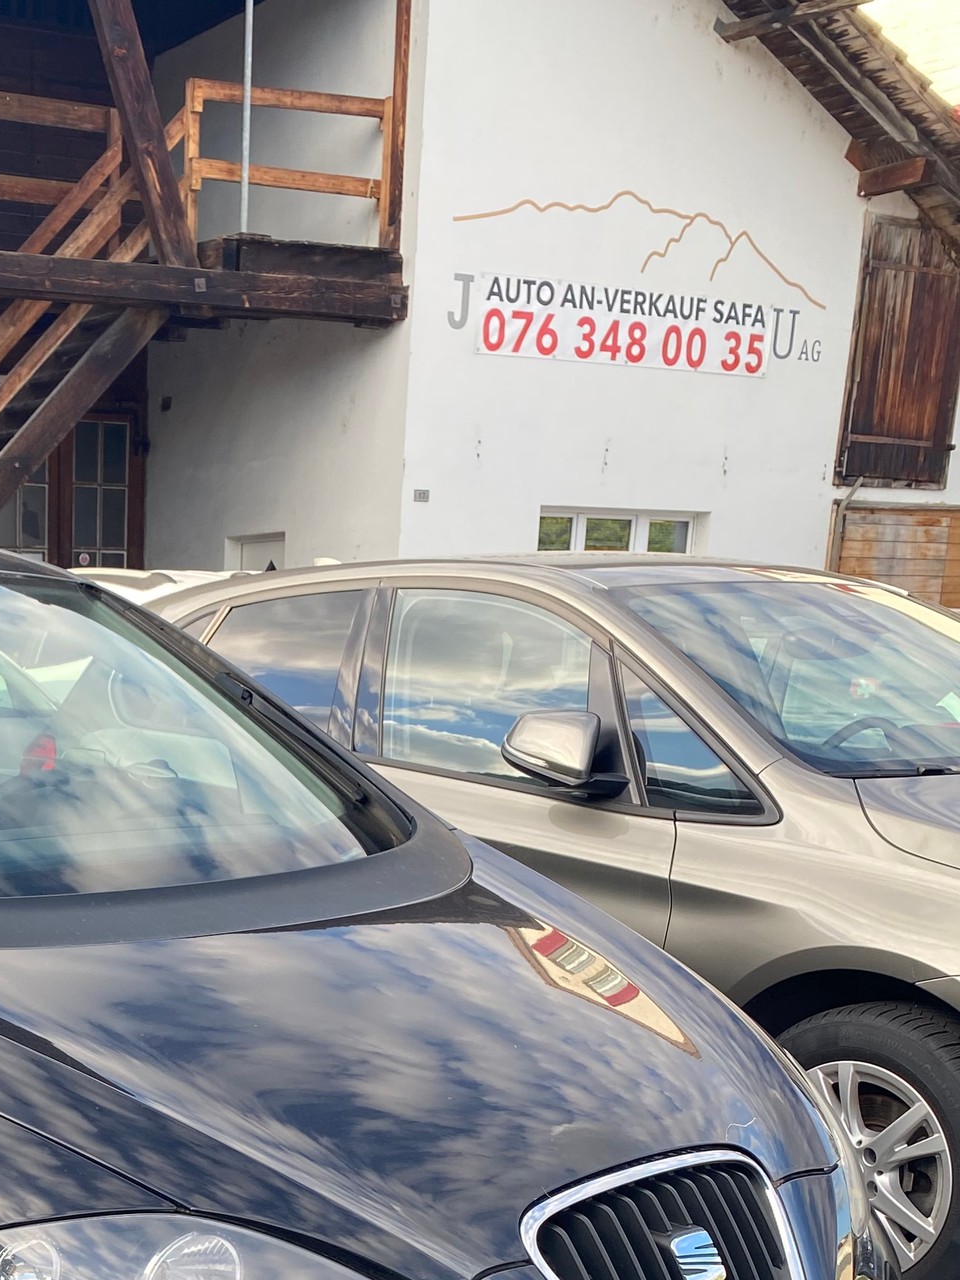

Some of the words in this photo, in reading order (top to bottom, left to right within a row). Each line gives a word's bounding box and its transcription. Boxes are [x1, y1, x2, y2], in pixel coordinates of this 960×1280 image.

[486, 276, 555, 306] AUTO
[559, 283, 708, 321] AN-VERKAUF
[712, 299, 766, 329] SAFA
[482, 307, 558, 356] 076
[574, 315, 647, 363] 348
[661, 324, 707, 369] 00
[721, 331, 765, 374] 35
[798, 339, 822, 363] AG
